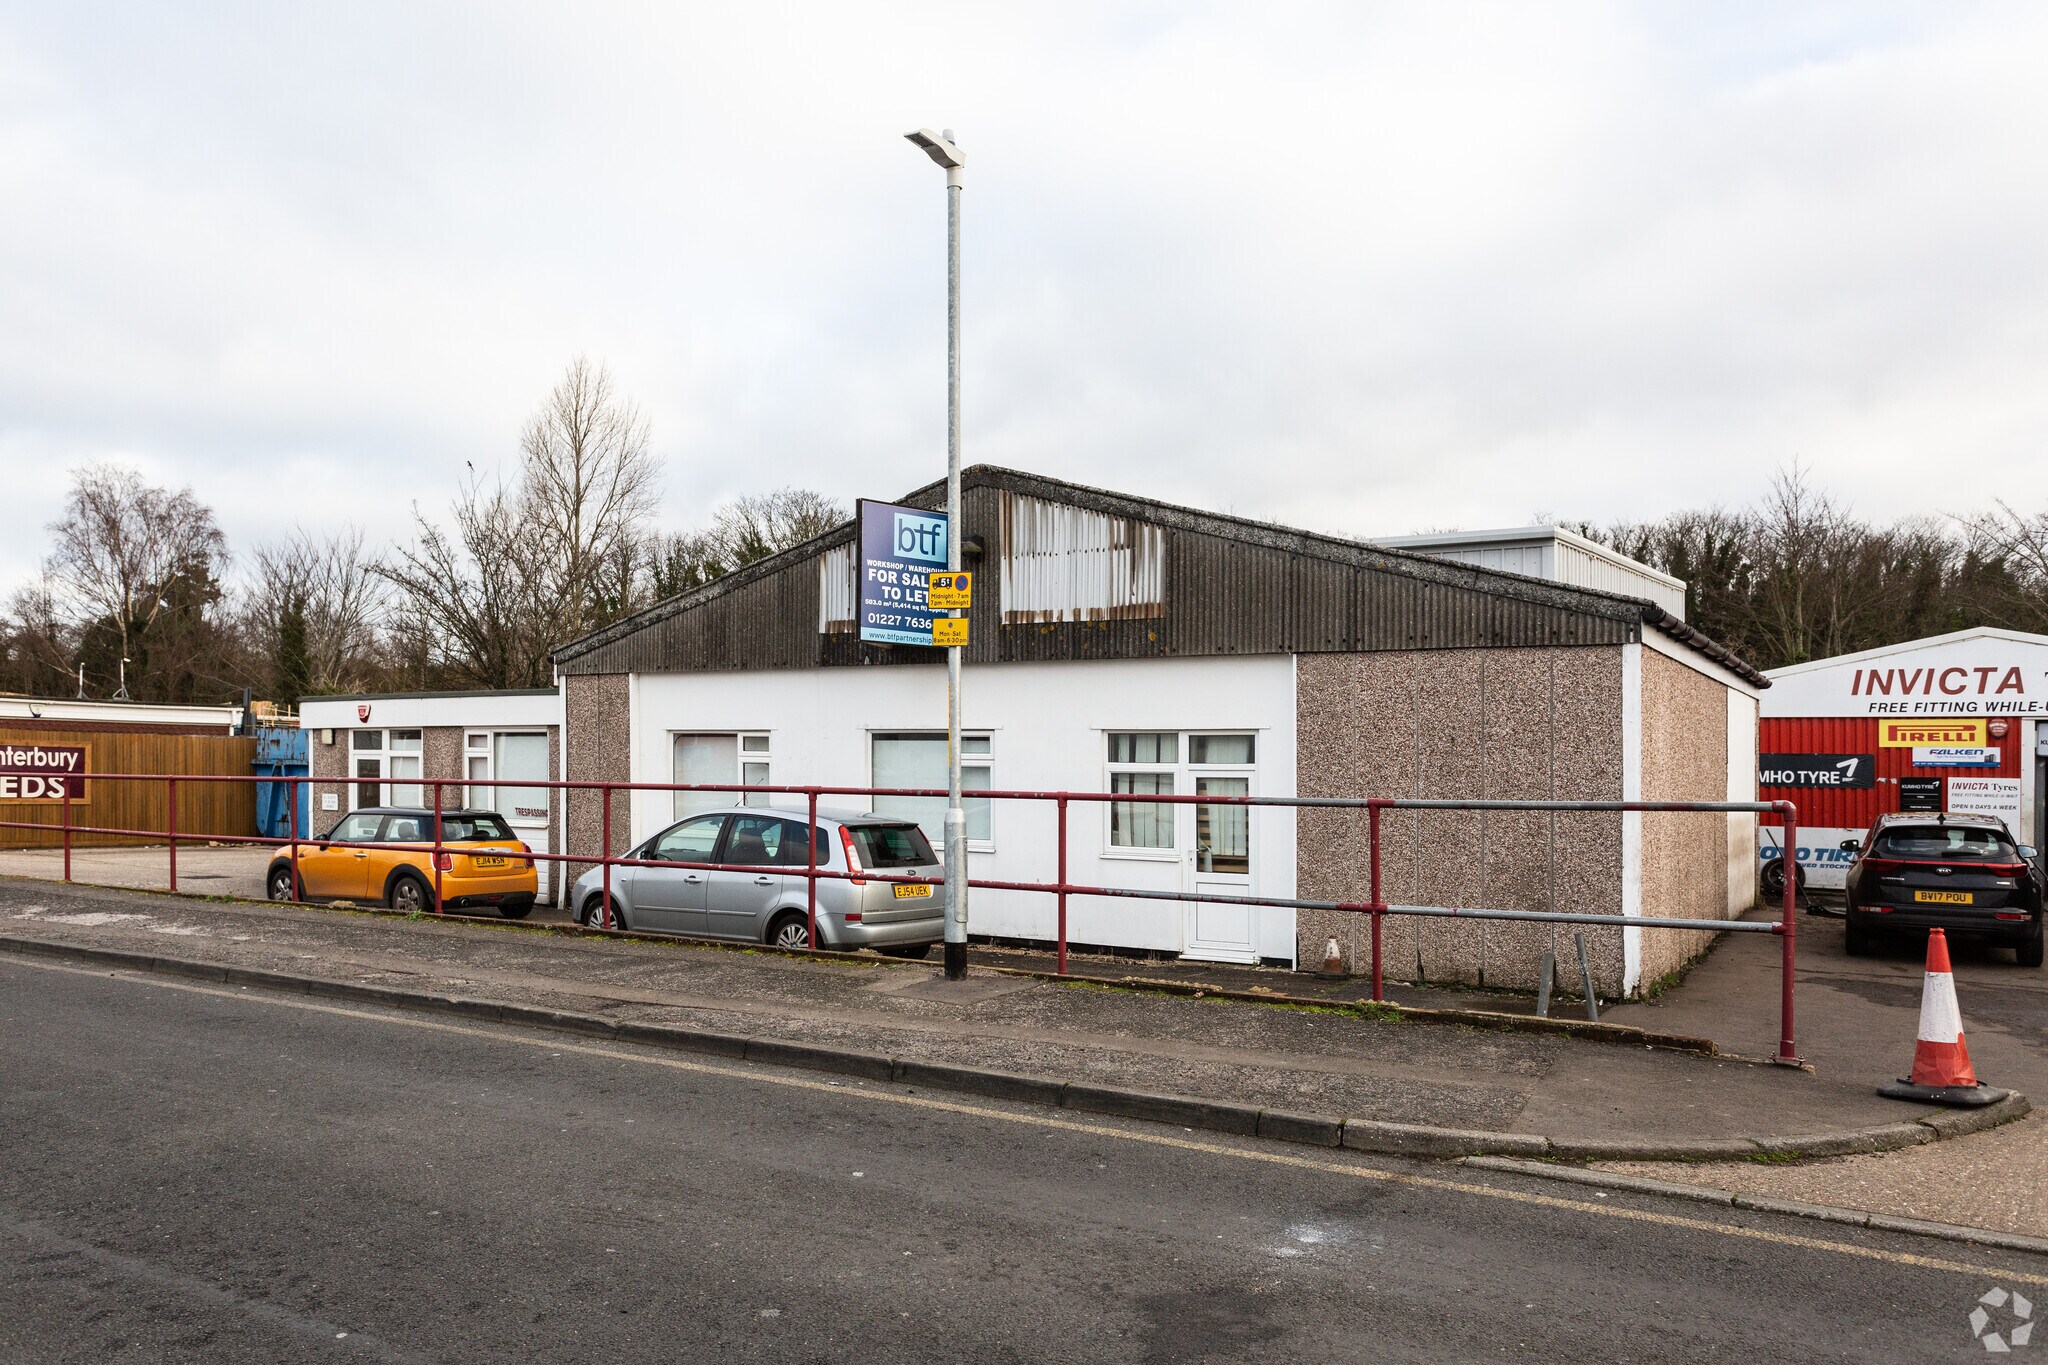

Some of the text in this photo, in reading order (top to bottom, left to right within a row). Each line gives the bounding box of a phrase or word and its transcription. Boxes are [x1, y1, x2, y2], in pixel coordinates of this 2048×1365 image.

[898, 518, 941, 556] btf
[866, 559, 904, 570] WORKSHOP
[868, 568, 898, 584] FOR
[881, 585, 929, 603] TO LET
[864, 598, 882, 606] 503.0
[920, 604, 928, 612] ft)
[868, 612, 932, 629] 01227 7636
[1851, 666, 2025, 696] INVICTA
[1868, 701, 2048, 713] FREE FITTING WHILE-
[1887, 724, 1977, 742] PIRELLI
[1797, 770, 1840, 784] TYRE
[0, 776, 66, 798] EDS
[1951, 782, 2018, 793] INVICTA Tyres
[897, 885, 929, 897] EJ54 UEK
[1921, 891, 1943, 901] BV17
